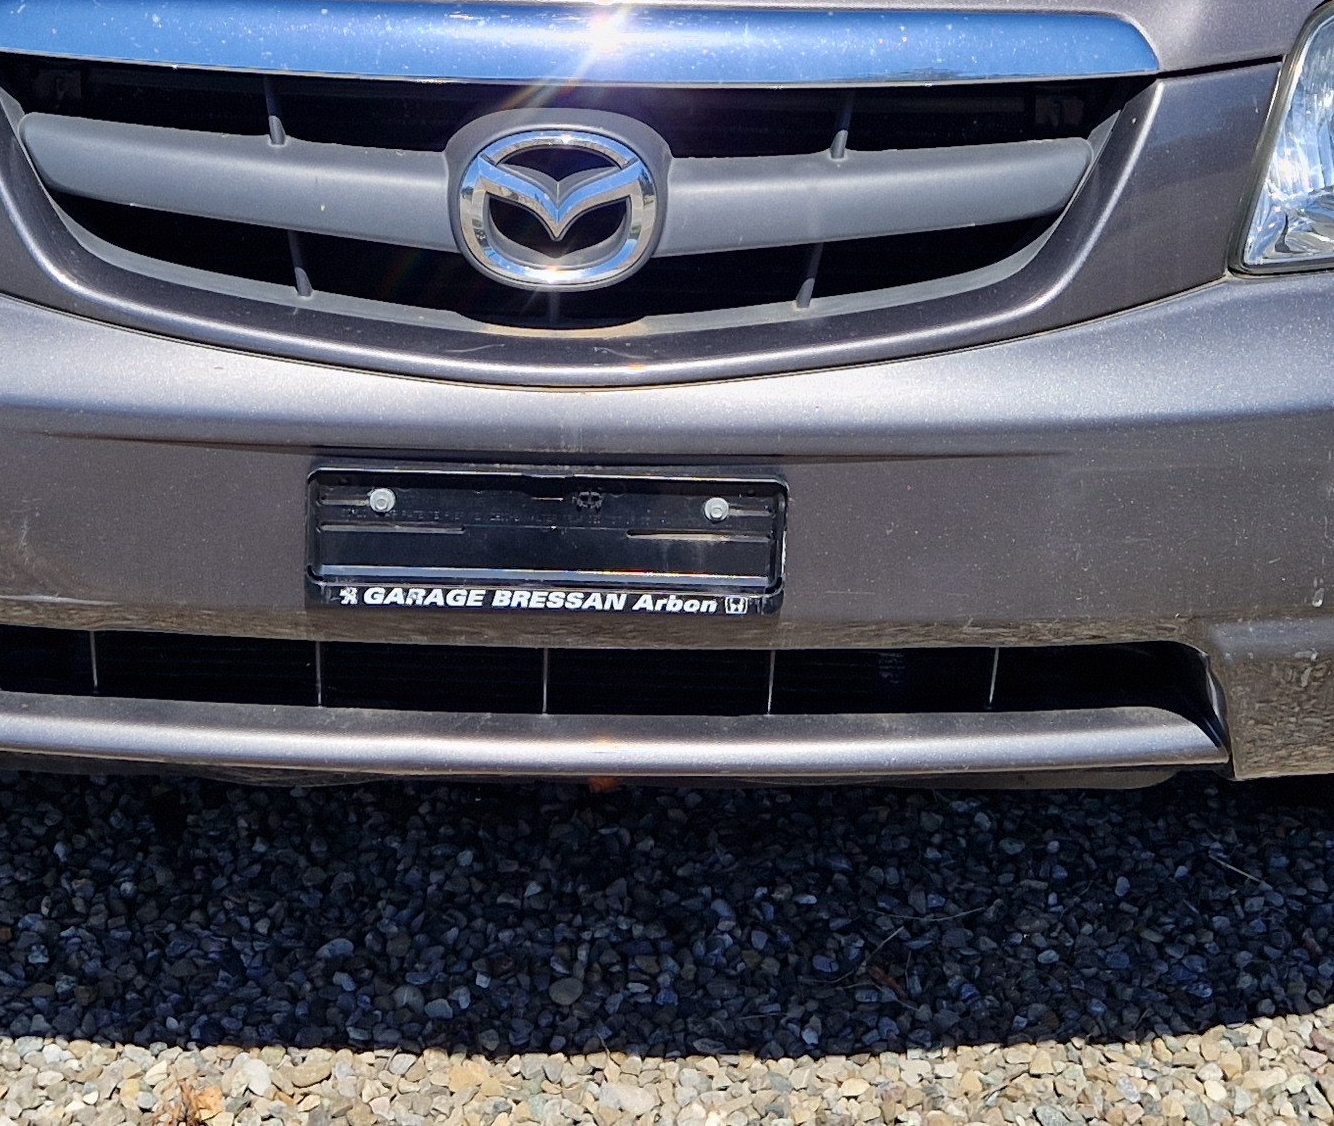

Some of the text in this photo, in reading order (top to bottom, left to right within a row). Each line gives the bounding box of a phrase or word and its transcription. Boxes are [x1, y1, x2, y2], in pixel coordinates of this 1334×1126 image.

[363, 586, 717, 614] GARAGE BRESSAN Arbon
